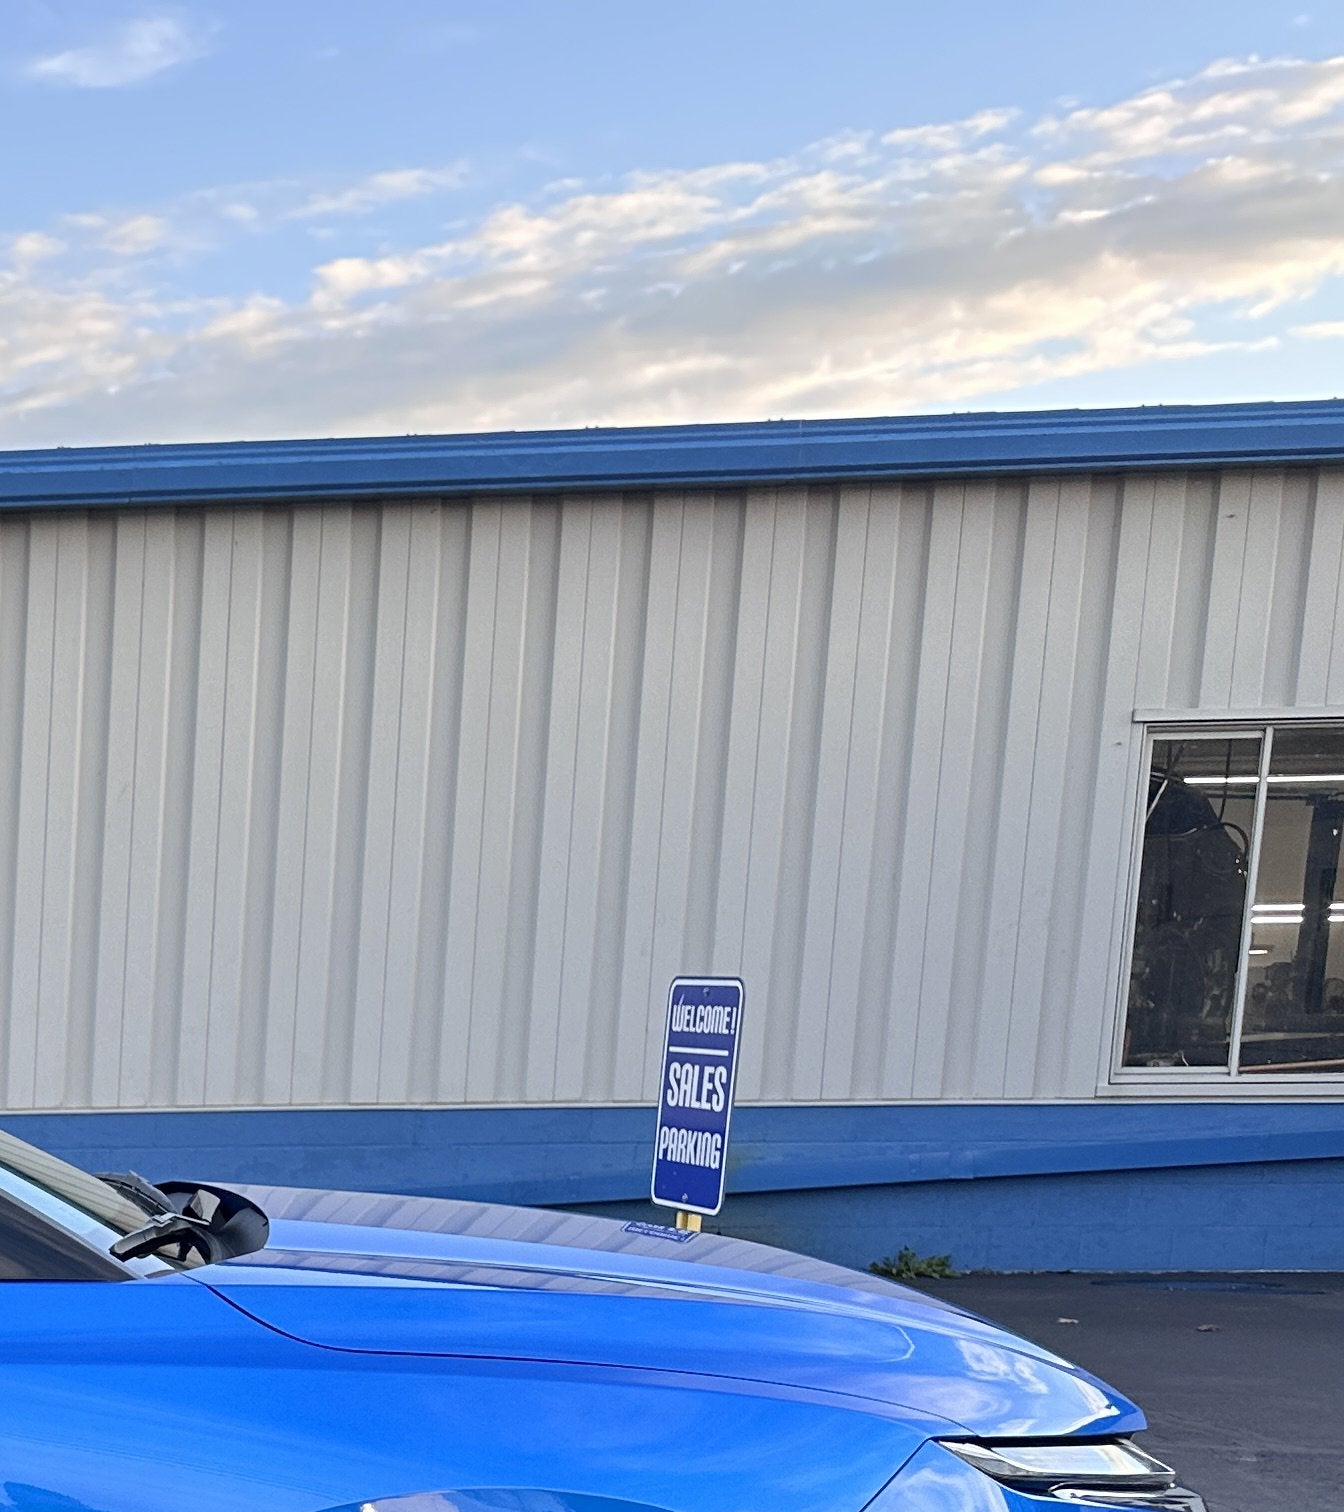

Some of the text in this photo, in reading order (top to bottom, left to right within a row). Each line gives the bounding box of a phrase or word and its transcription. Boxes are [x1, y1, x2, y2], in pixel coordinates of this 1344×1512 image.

[671, 994, 737, 1035] WELCOME!
[666, 1061, 726, 1113] SALES
[658, 1126, 722, 1169] PARKING
